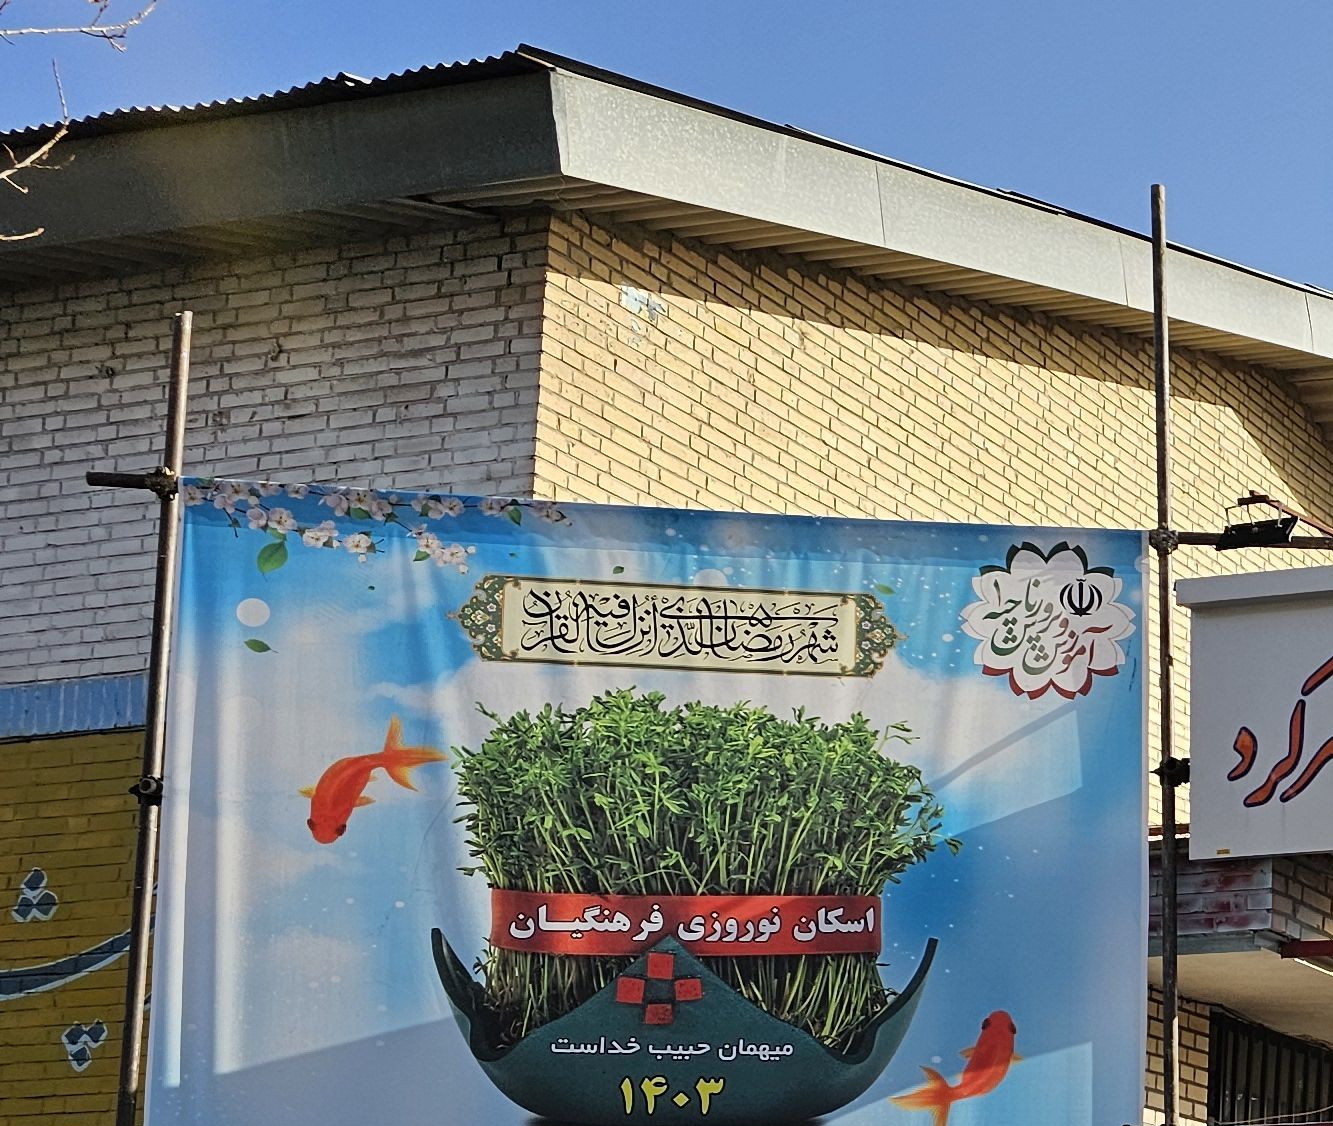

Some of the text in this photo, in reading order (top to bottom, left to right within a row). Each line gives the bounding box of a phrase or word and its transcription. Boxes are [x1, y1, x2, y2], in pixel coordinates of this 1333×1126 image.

[509, 904, 875, 942] اسکان نوروزی فرهنگیان
[550, 1036, 794, 1061] میهمان حبیب خداست
[619, 1076, 724, 1115] ۱۴۰۳
